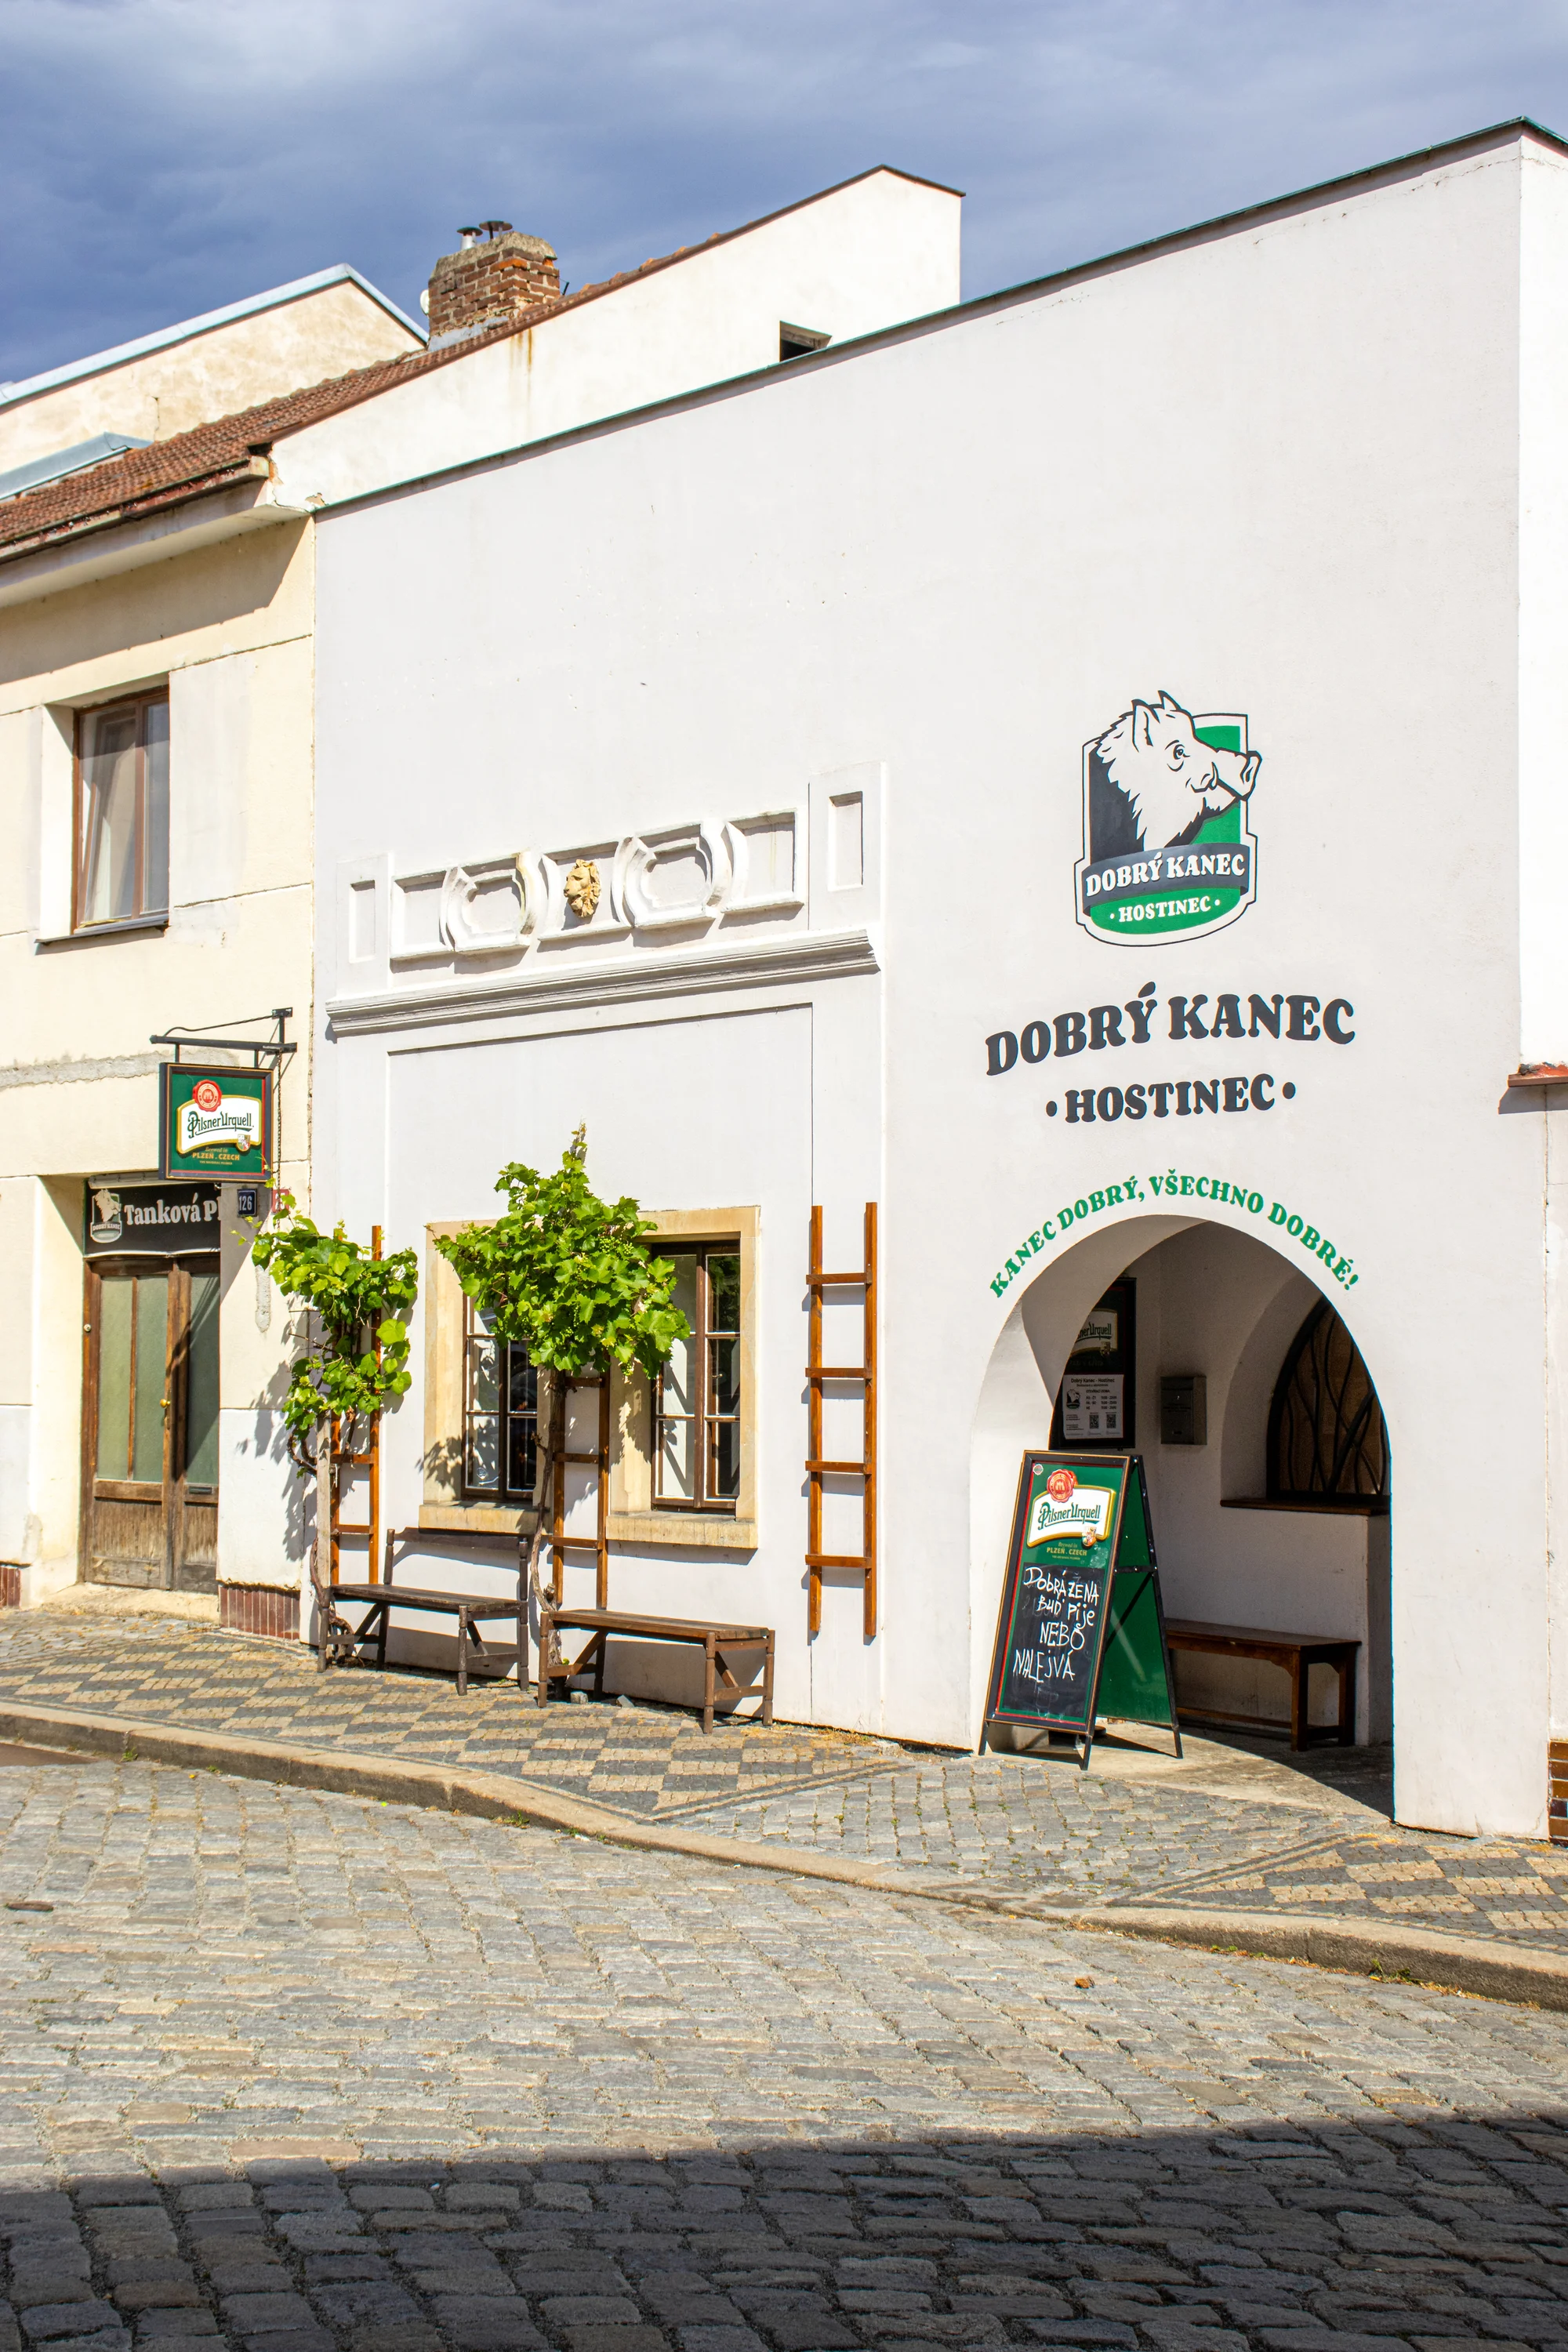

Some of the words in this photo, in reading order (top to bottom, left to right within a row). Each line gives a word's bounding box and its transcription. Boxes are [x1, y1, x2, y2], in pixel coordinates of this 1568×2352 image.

[1086, 851, 1164, 898] DOBRÝ
[1166, 852, 1247, 880] KANEC
[1118, 895, 1212, 923] HOSTINEC
[985, 981, 1158, 1076] DOBRÝ
[1167, 993, 1356, 1046] KANEC
[1064, 1073, 1276, 1123] HOSTINEC
[187, 1110, 220, 1138] Pilsner
[124, 1192, 201, 1225] Tanková
[238, 1195, 252, 1211] 126
[989, 1220, 1058, 1298] KANEC
[1057, 1174, 1145, 1231] DOBRÝ,
[1148, 1168, 1265, 1214] VŠECHNO
[1267, 1201, 1359, 1291] DOBRÉ!
[1088, 1322, 1112, 1340] Urquell
[1037, 1501, 1071, 1530] Pilsner
[1039, 1621, 1085, 1650] NEBO
